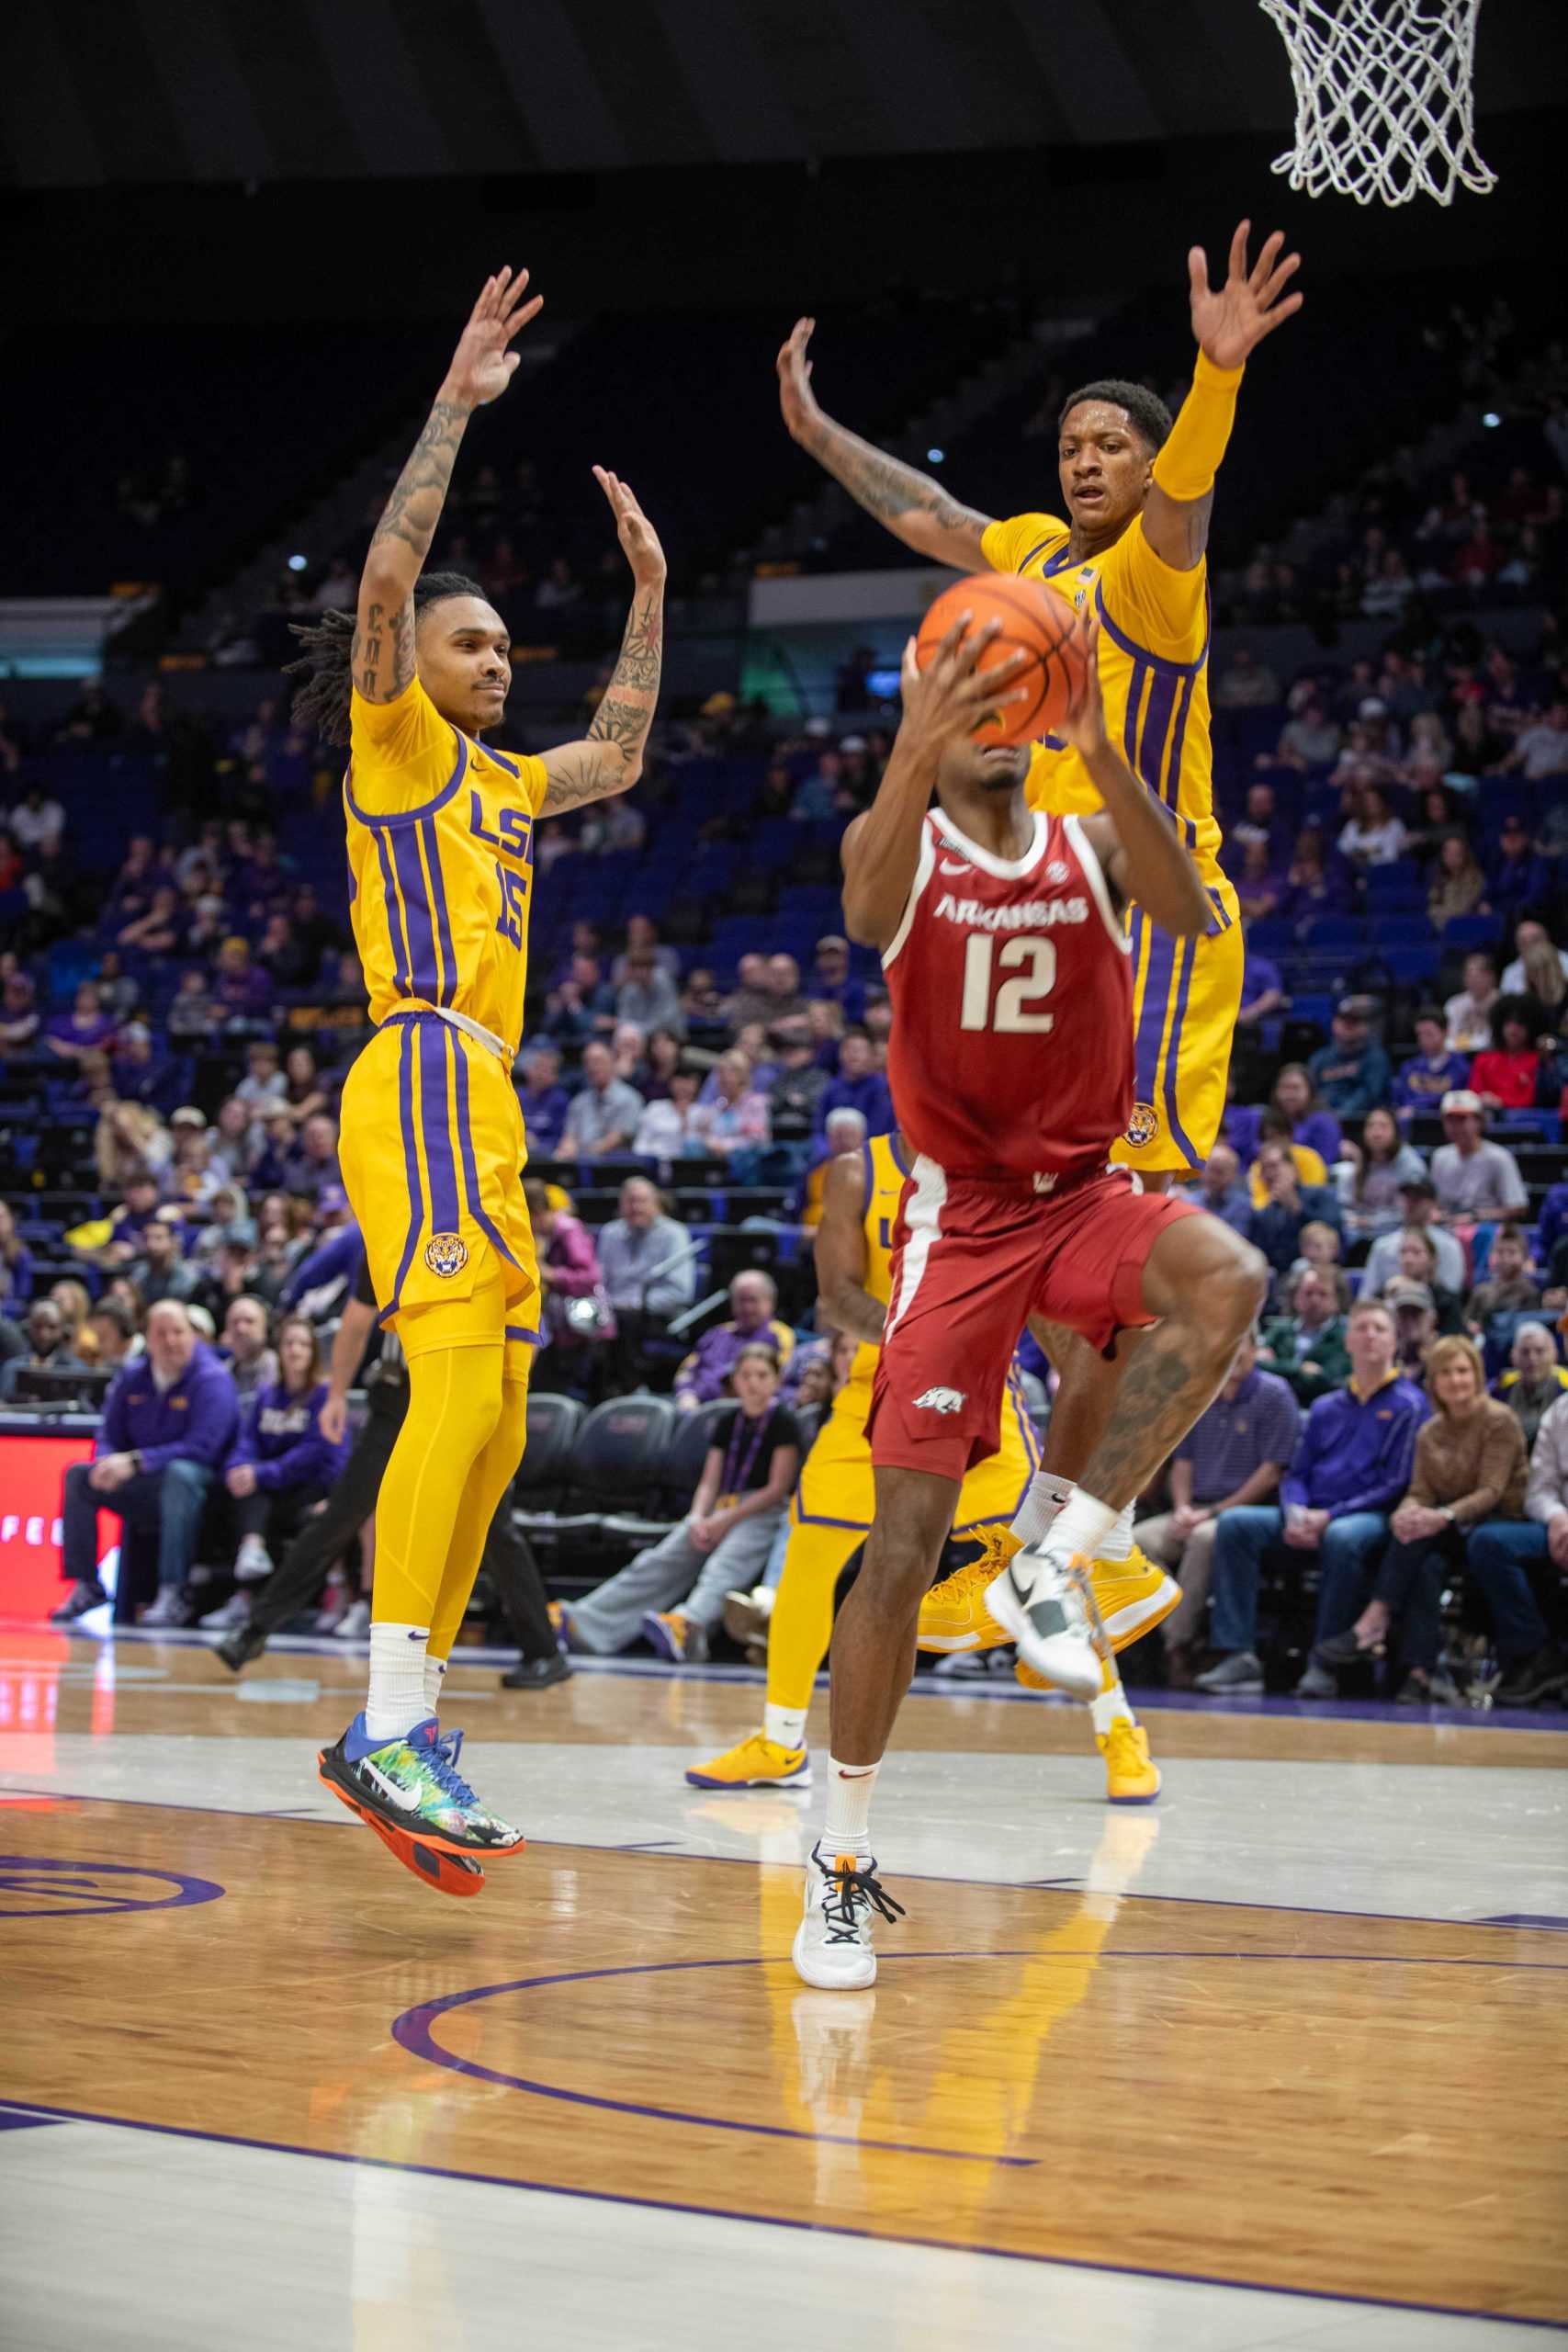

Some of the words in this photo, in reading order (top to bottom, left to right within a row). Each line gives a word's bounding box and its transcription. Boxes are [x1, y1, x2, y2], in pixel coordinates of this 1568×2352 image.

[470, 790, 534, 865] LS
[496, 861, 527, 952] 15
[933, 893, 1089, 930] ARKANSAS
[960, 933, 1057, 1034] 12
